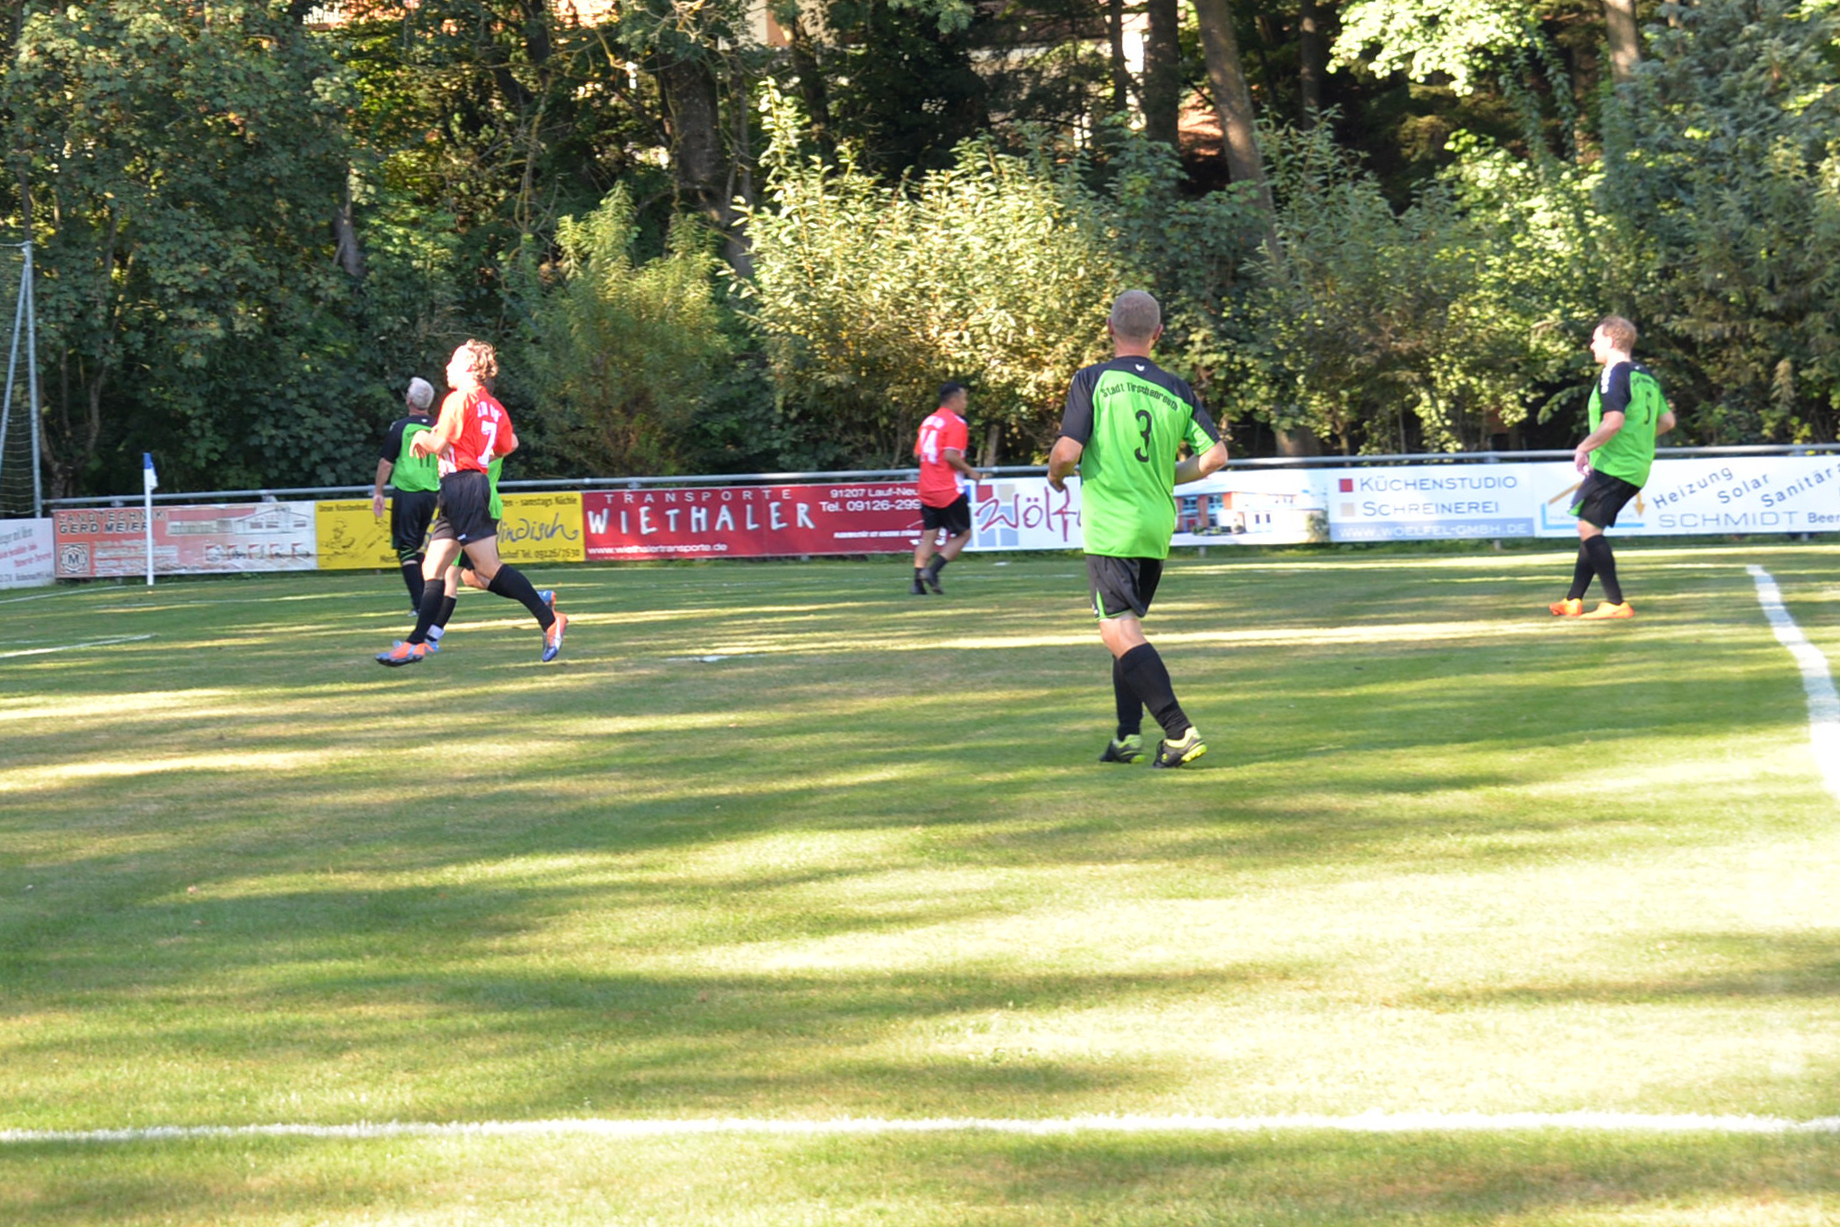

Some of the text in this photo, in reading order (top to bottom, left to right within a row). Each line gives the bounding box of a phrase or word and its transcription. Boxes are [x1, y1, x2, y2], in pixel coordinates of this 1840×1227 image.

[1100, 383, 1125, 398] Stadt
[477, 420, 498, 468] 7
[1134, 409, 1152, 463] 3
[830, 488, 866, 498] 91207
[1360, 476, 1518, 493] KÜCHENSTUDIO
[1653, 467, 1734, 510] Heizung
[1717, 473, 1770, 506] Solar
[1760, 463, 1840, 508] Sanitär
[605, 488, 792, 505] TRANSPORTE
[819, 501, 843, 512] Tel.
[1363, 501, 1500, 517] SCHREINEREI
[58, 510, 164, 525] LANDTECHNK
[587, 501, 816, 536] WIETHALER
[1659, 511, 1799, 528] SCHMIDT
[60, 522, 100, 535] GERD
[587, 542, 728, 556] www.wiethalertransporte.de
